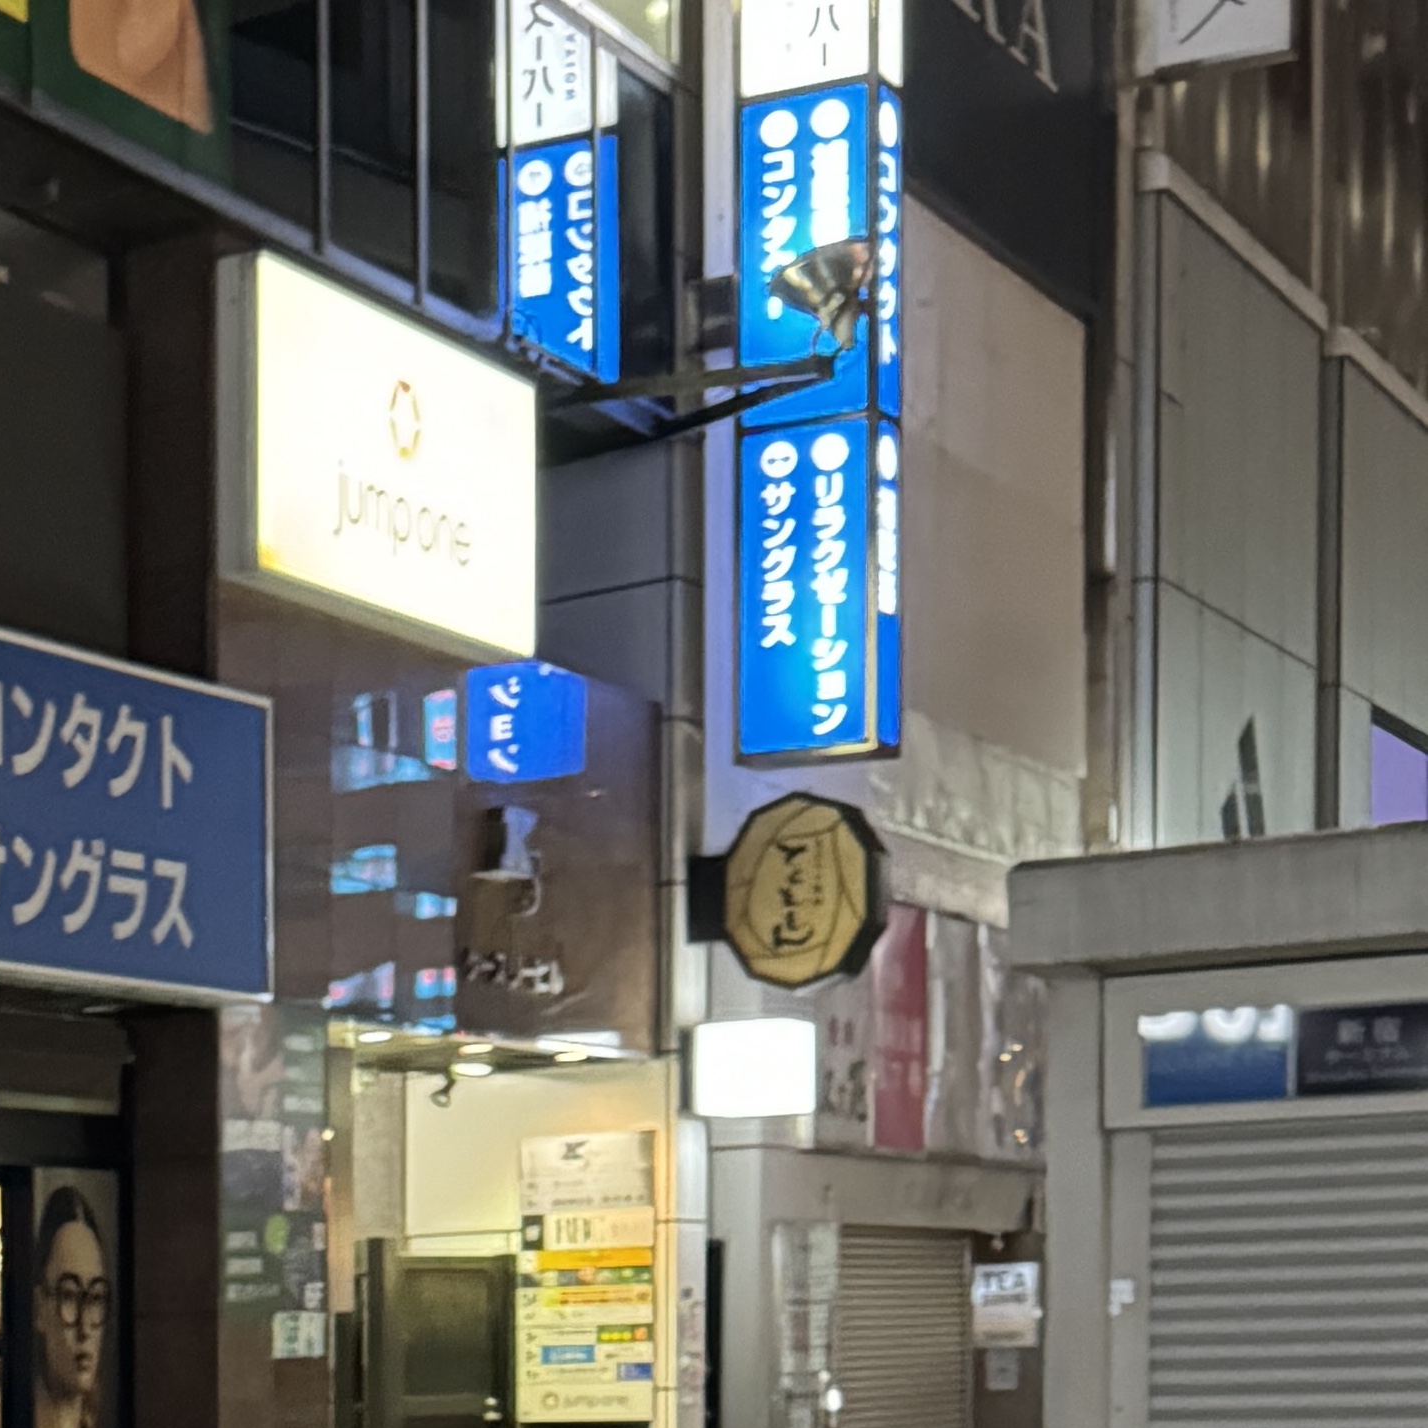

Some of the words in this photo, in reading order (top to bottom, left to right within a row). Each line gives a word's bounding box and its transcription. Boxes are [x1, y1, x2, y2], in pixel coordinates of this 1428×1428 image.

[760, 481, 797, 648] サングラス
[811, 472, 849, 736] リラクゼーション
